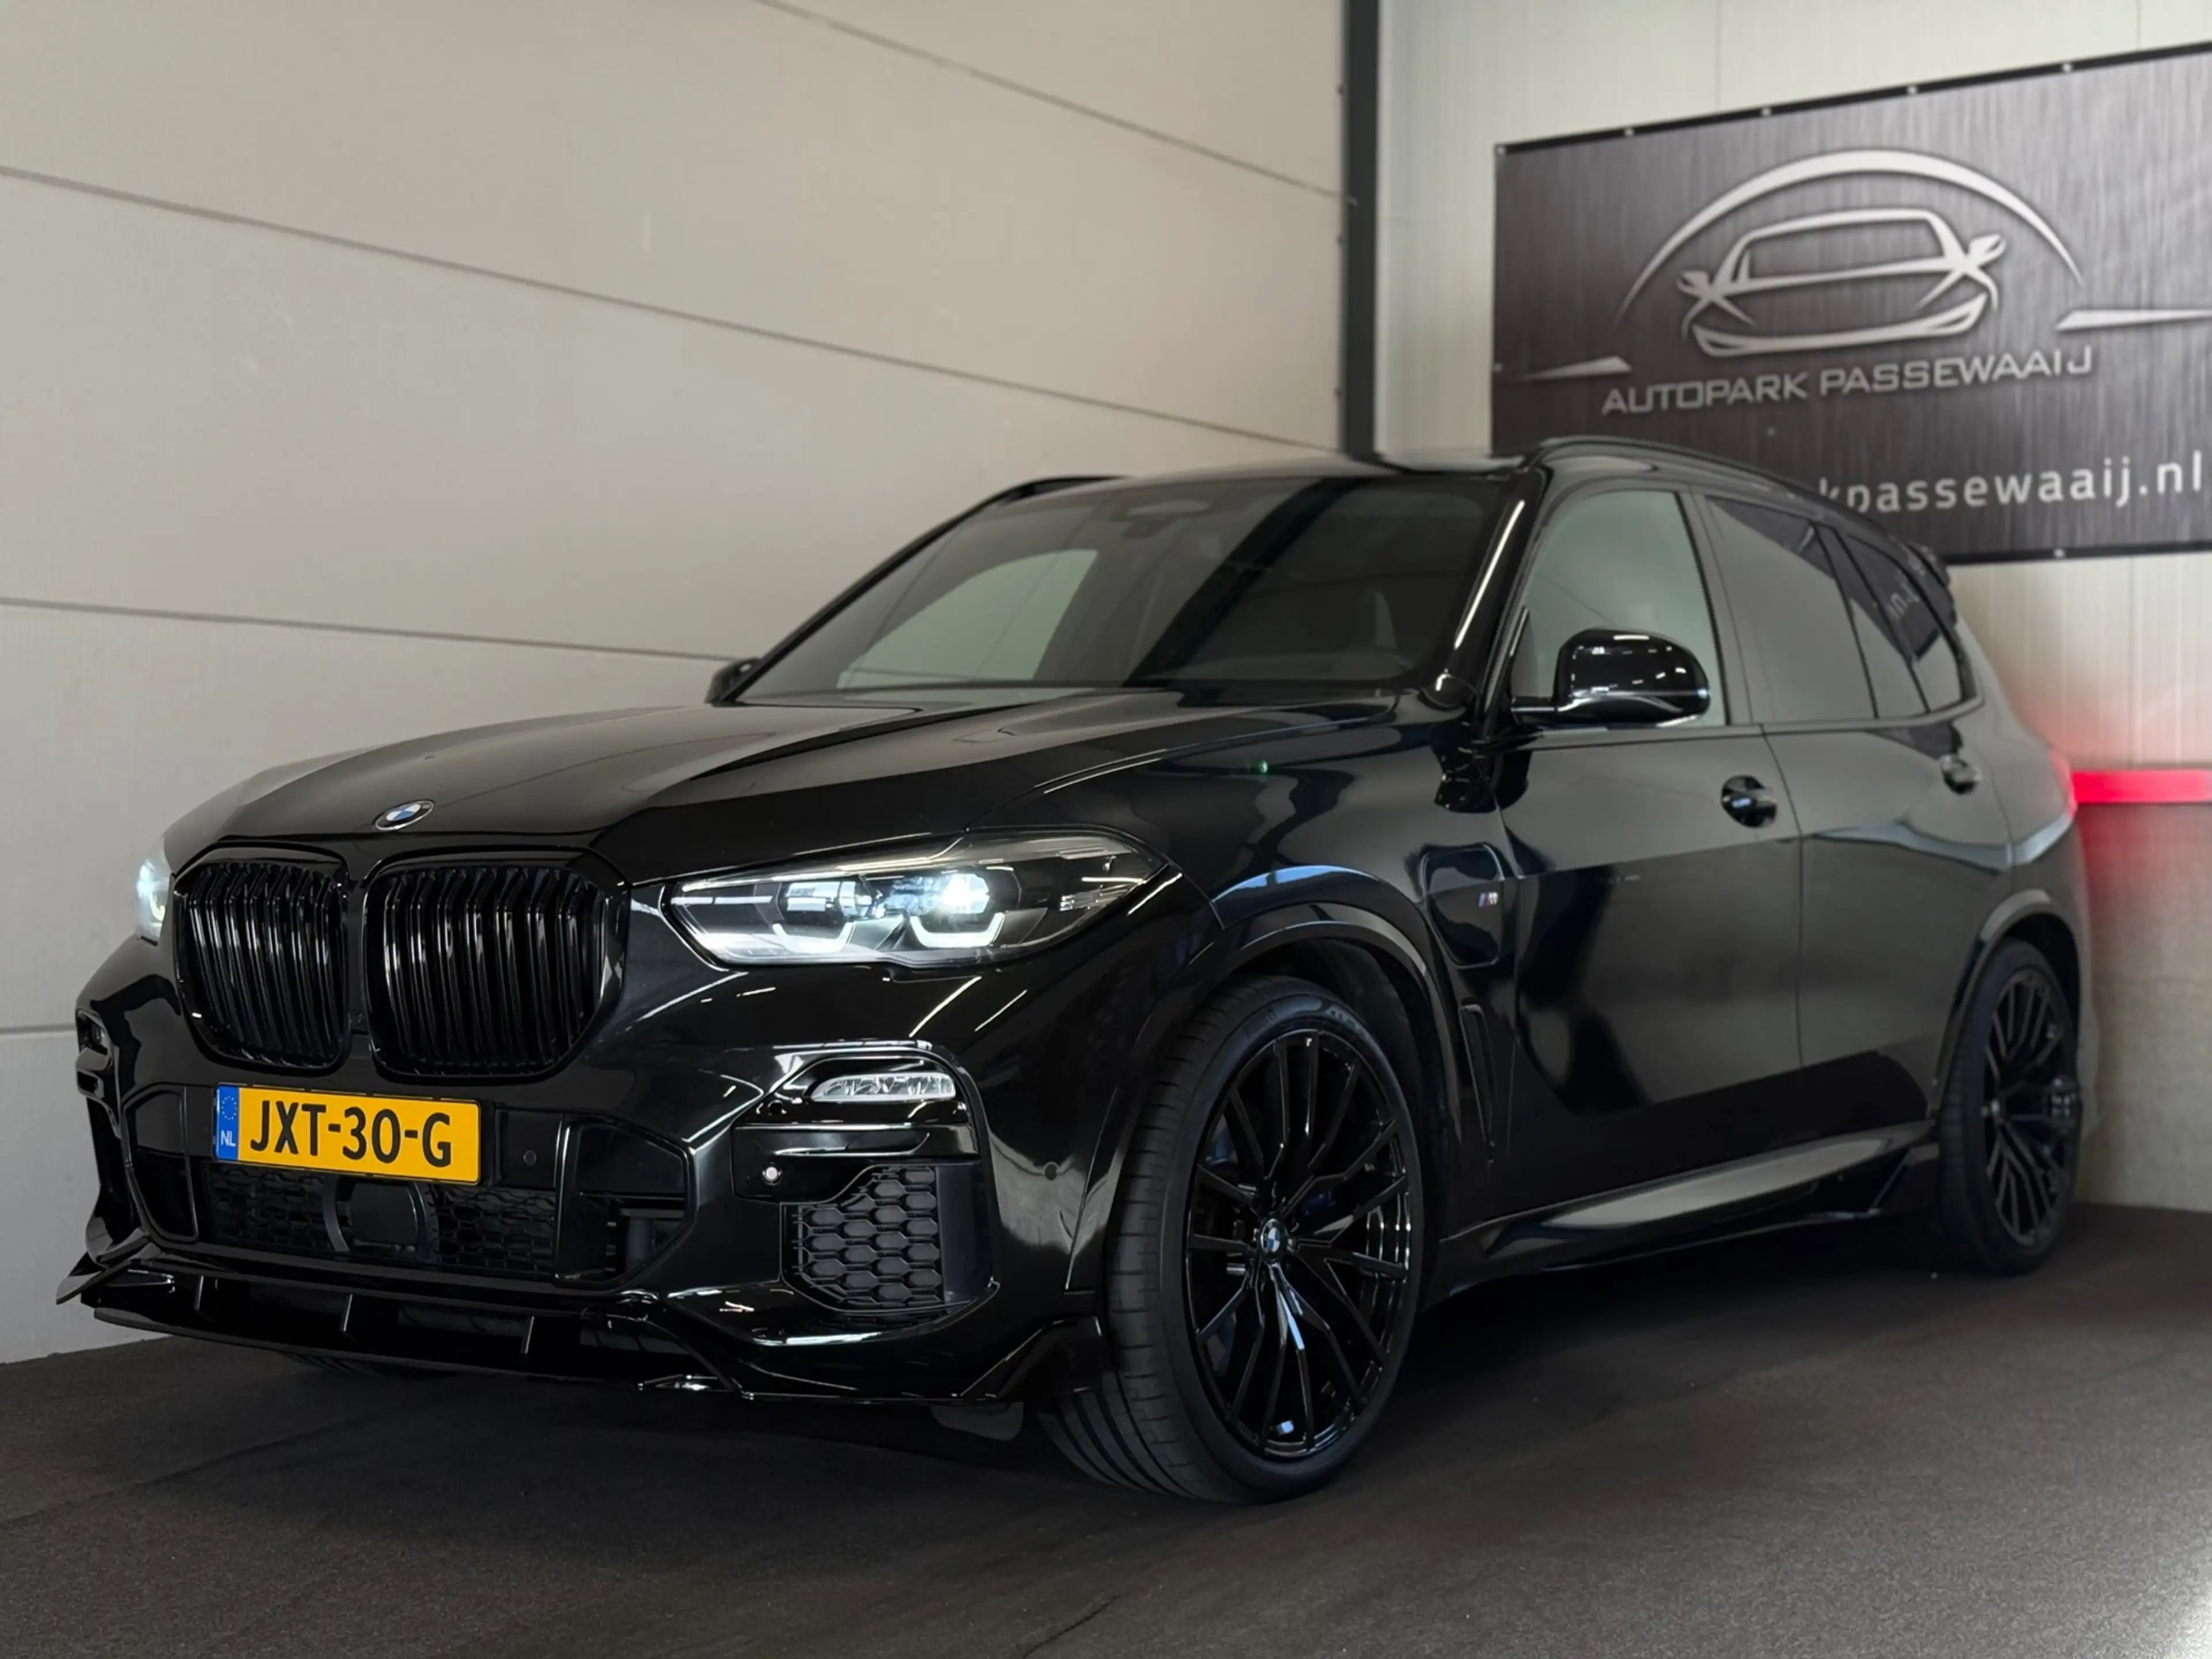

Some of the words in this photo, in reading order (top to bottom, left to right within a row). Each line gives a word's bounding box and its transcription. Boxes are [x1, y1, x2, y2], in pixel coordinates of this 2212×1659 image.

[1601, 371, 1809, 416] AUTOPARK
[1820, 345, 2092, 396] PASSEWAAIJ
[220, 1129, 236, 1147] NL
[249, 1099, 452, 1168] JXT-30-G
